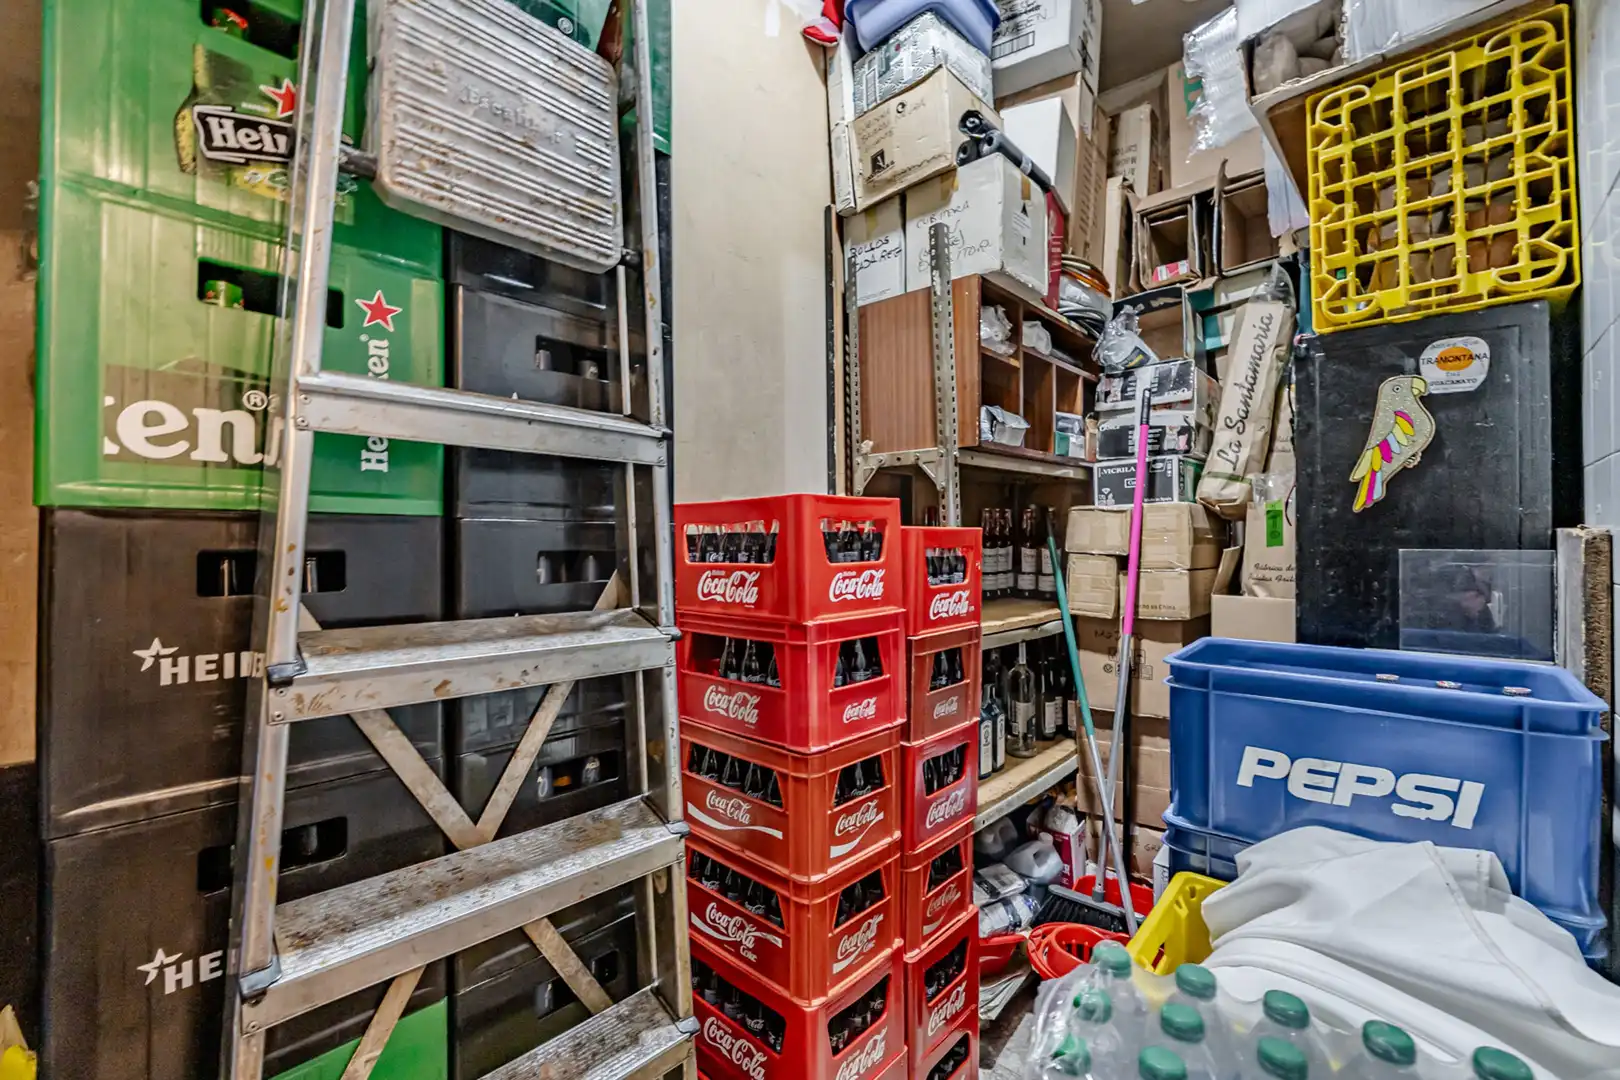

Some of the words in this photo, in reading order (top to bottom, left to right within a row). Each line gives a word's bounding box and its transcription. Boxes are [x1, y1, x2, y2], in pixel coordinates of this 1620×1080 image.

[1421, 352, 1490, 366] TRAMONTANA
[1217, 440, 1243, 472] La
[1236, 745, 1486, 830] PEPSI
